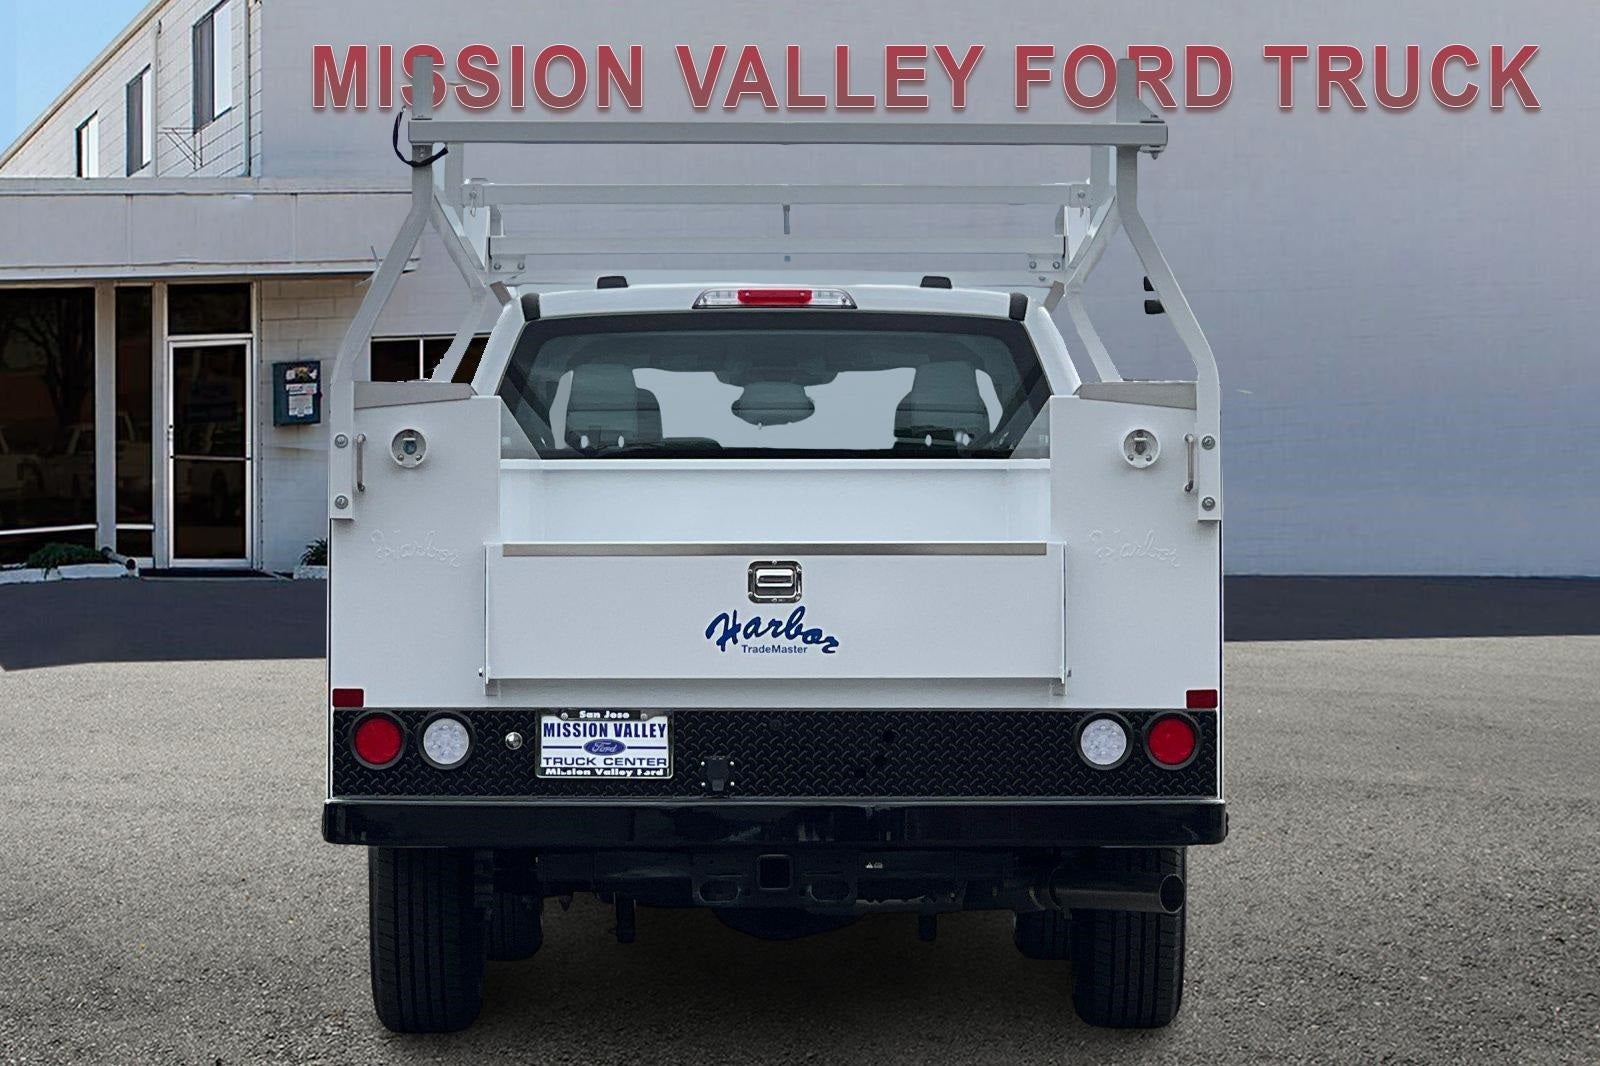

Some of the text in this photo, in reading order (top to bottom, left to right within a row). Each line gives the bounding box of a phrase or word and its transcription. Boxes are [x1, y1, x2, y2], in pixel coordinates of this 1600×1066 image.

[312, 43, 1542, 109] MISSION VALLEY FORD TRUCK
[705, 605, 840, 654] Harbor
[741, 644, 808, 654] TradeMaster
[579, 710, 630, 719] San Jose
[543, 722, 667, 738] MISSION VALLEY
[543, 757, 667, 767] TRUCK CENTER
[595, 768, 633, 777] Valley
